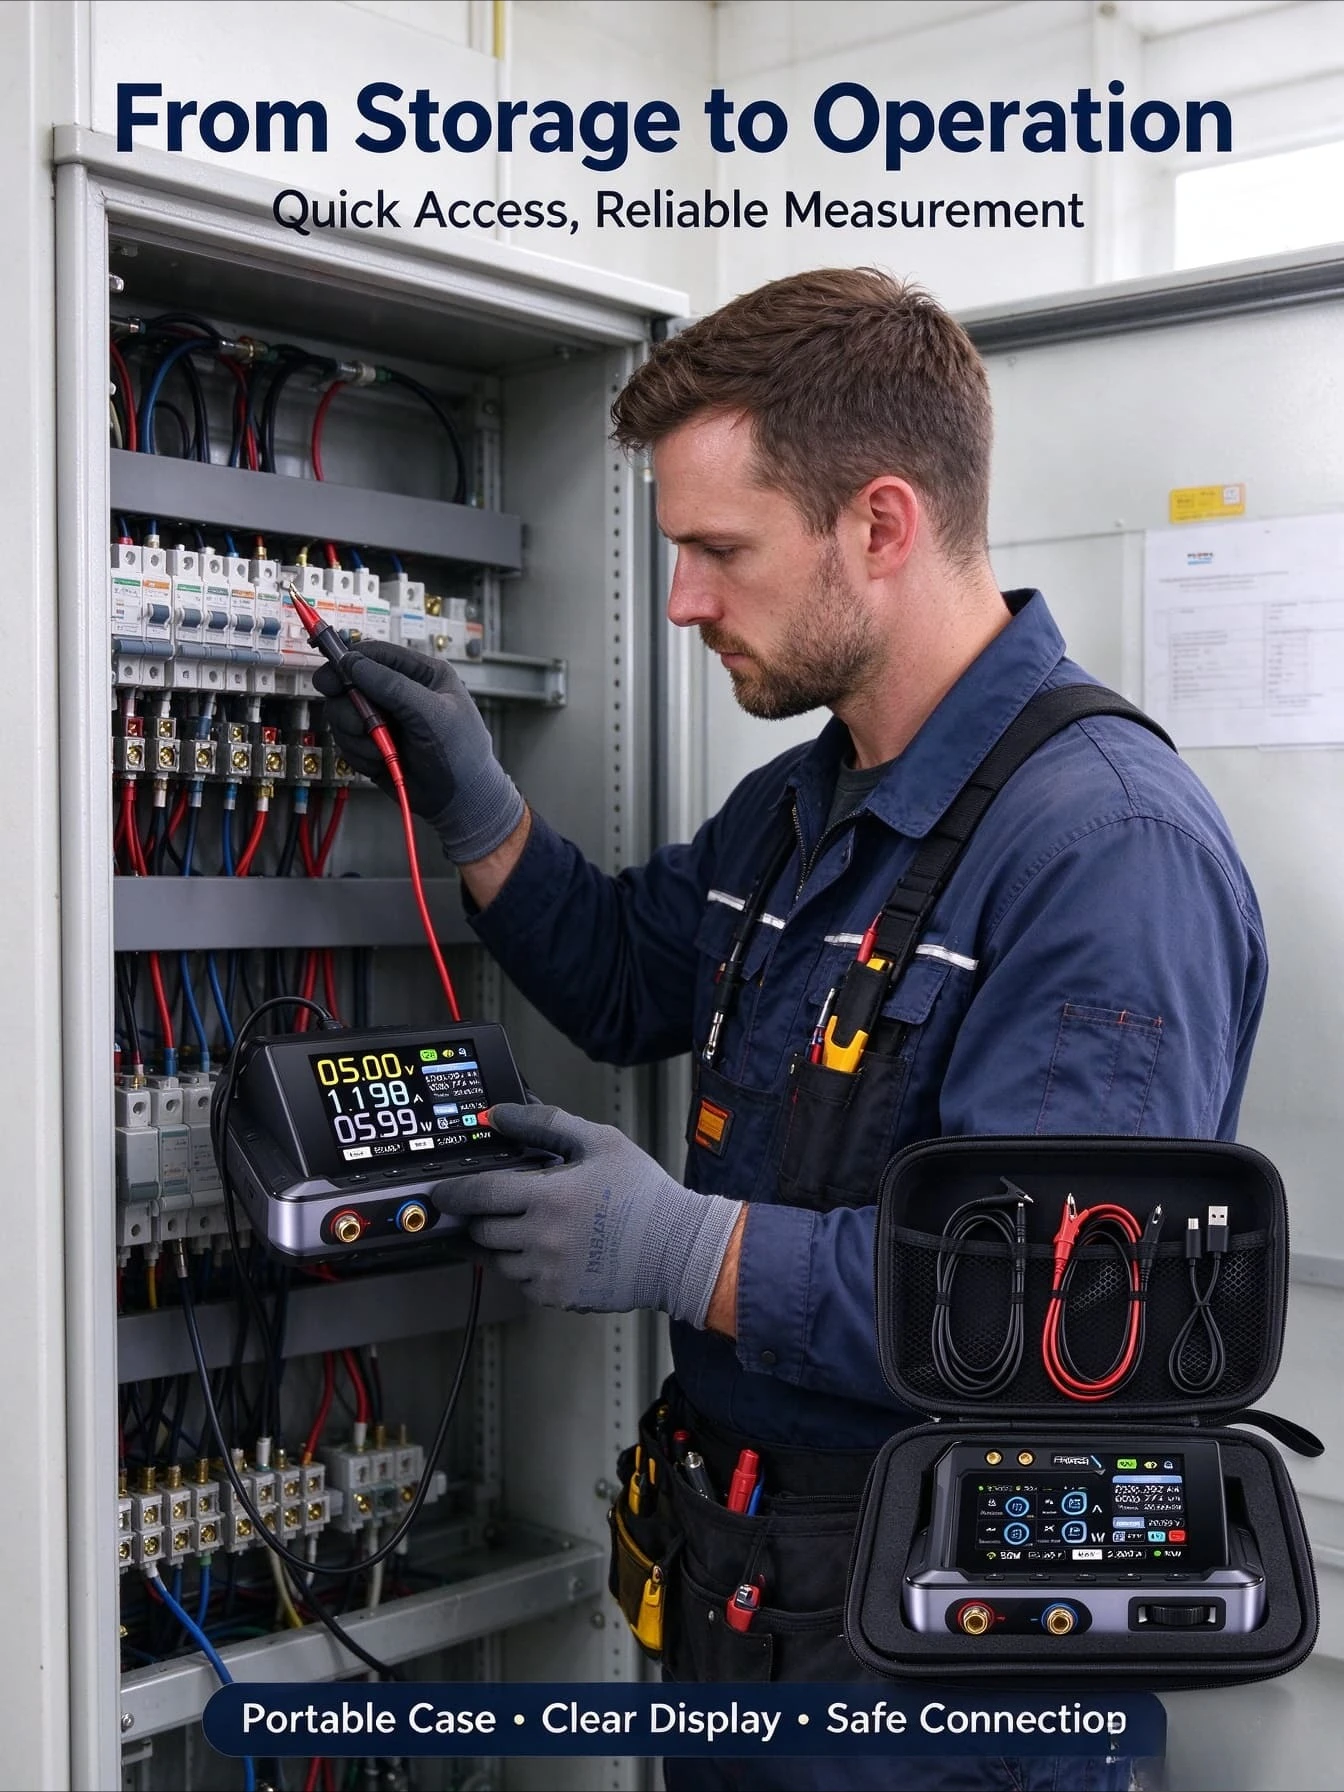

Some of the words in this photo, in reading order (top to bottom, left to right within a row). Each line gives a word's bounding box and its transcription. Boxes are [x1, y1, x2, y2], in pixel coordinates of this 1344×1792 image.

[317, 1053, 402, 1086] 05.00
[404, 1065, 414, 1076] V
[420, 1121, 432, 1132] W
